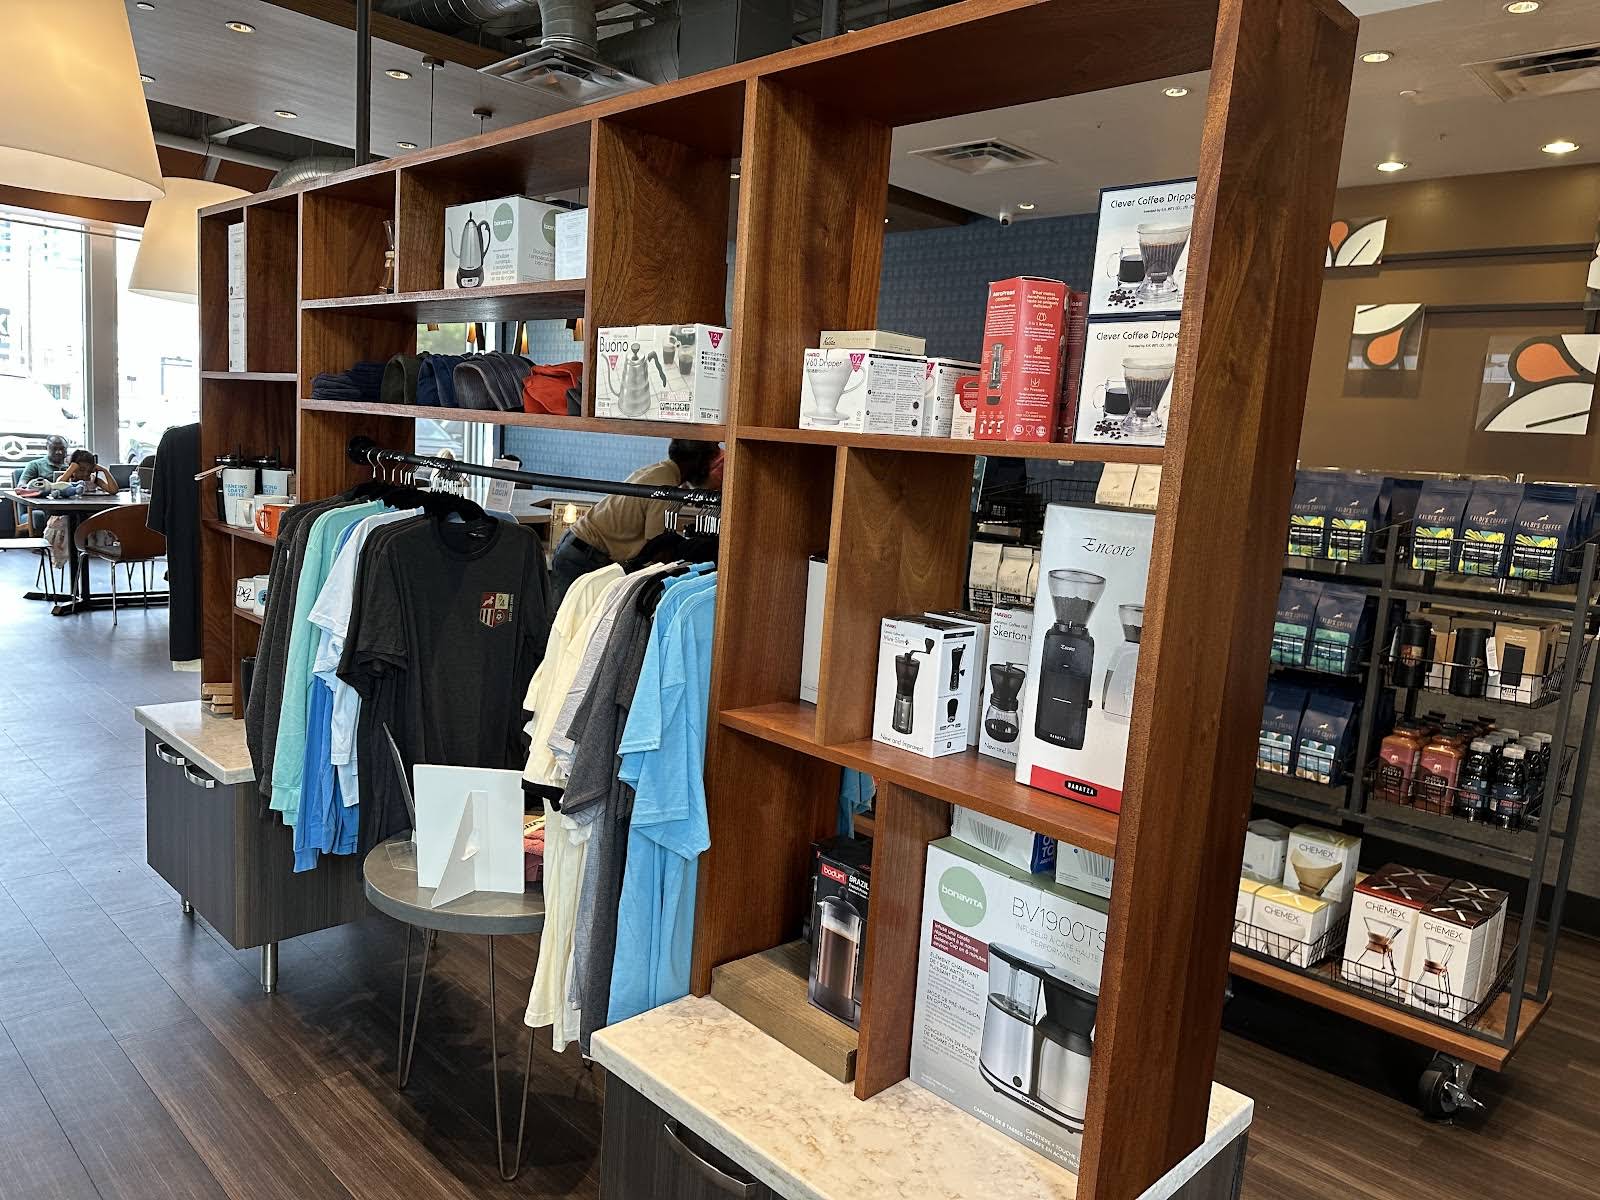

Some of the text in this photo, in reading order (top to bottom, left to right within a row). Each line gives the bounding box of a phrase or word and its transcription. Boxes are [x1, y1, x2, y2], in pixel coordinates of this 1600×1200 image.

[1110, 199, 1135, 208] Clever
[1138, 195, 1165, 206] Coffee
[1096, 332, 1120, 341] Clever
[1122, 330, 1149, 340] Coffee
[600, 336, 629, 353] Buono
[806, 358, 843, 369] V60 Dripper
[1541, 523, 1562, 531] COFFEE
[1082, 537, 1136, 557] Encore
[994, 611, 1012, 619] HARIO
[993, 625, 1027, 641] Skerton
[881, 733, 891, 742] New
[892, 736, 902, 745] and
[984, 742, 996, 750] New
[996, 745, 1006, 754] and
[1067, 782, 1094, 796] BARATZA
[1298, 842, 1335, 859] CHEMEX
[823, 866, 845, 882] bodum
[848, 875, 869, 890] BRAZIL
[1264, 905, 1299, 923] CHEMEX
[1365, 900, 1407, 920] CHEMEX
[1423, 921, 1464, 940] CHEMEX
[1030, 938, 1081, 965] PERFORMANCE
[1075, 946, 1099, 963] HAUTE
[933, 998, 951, 1011] OPTION
